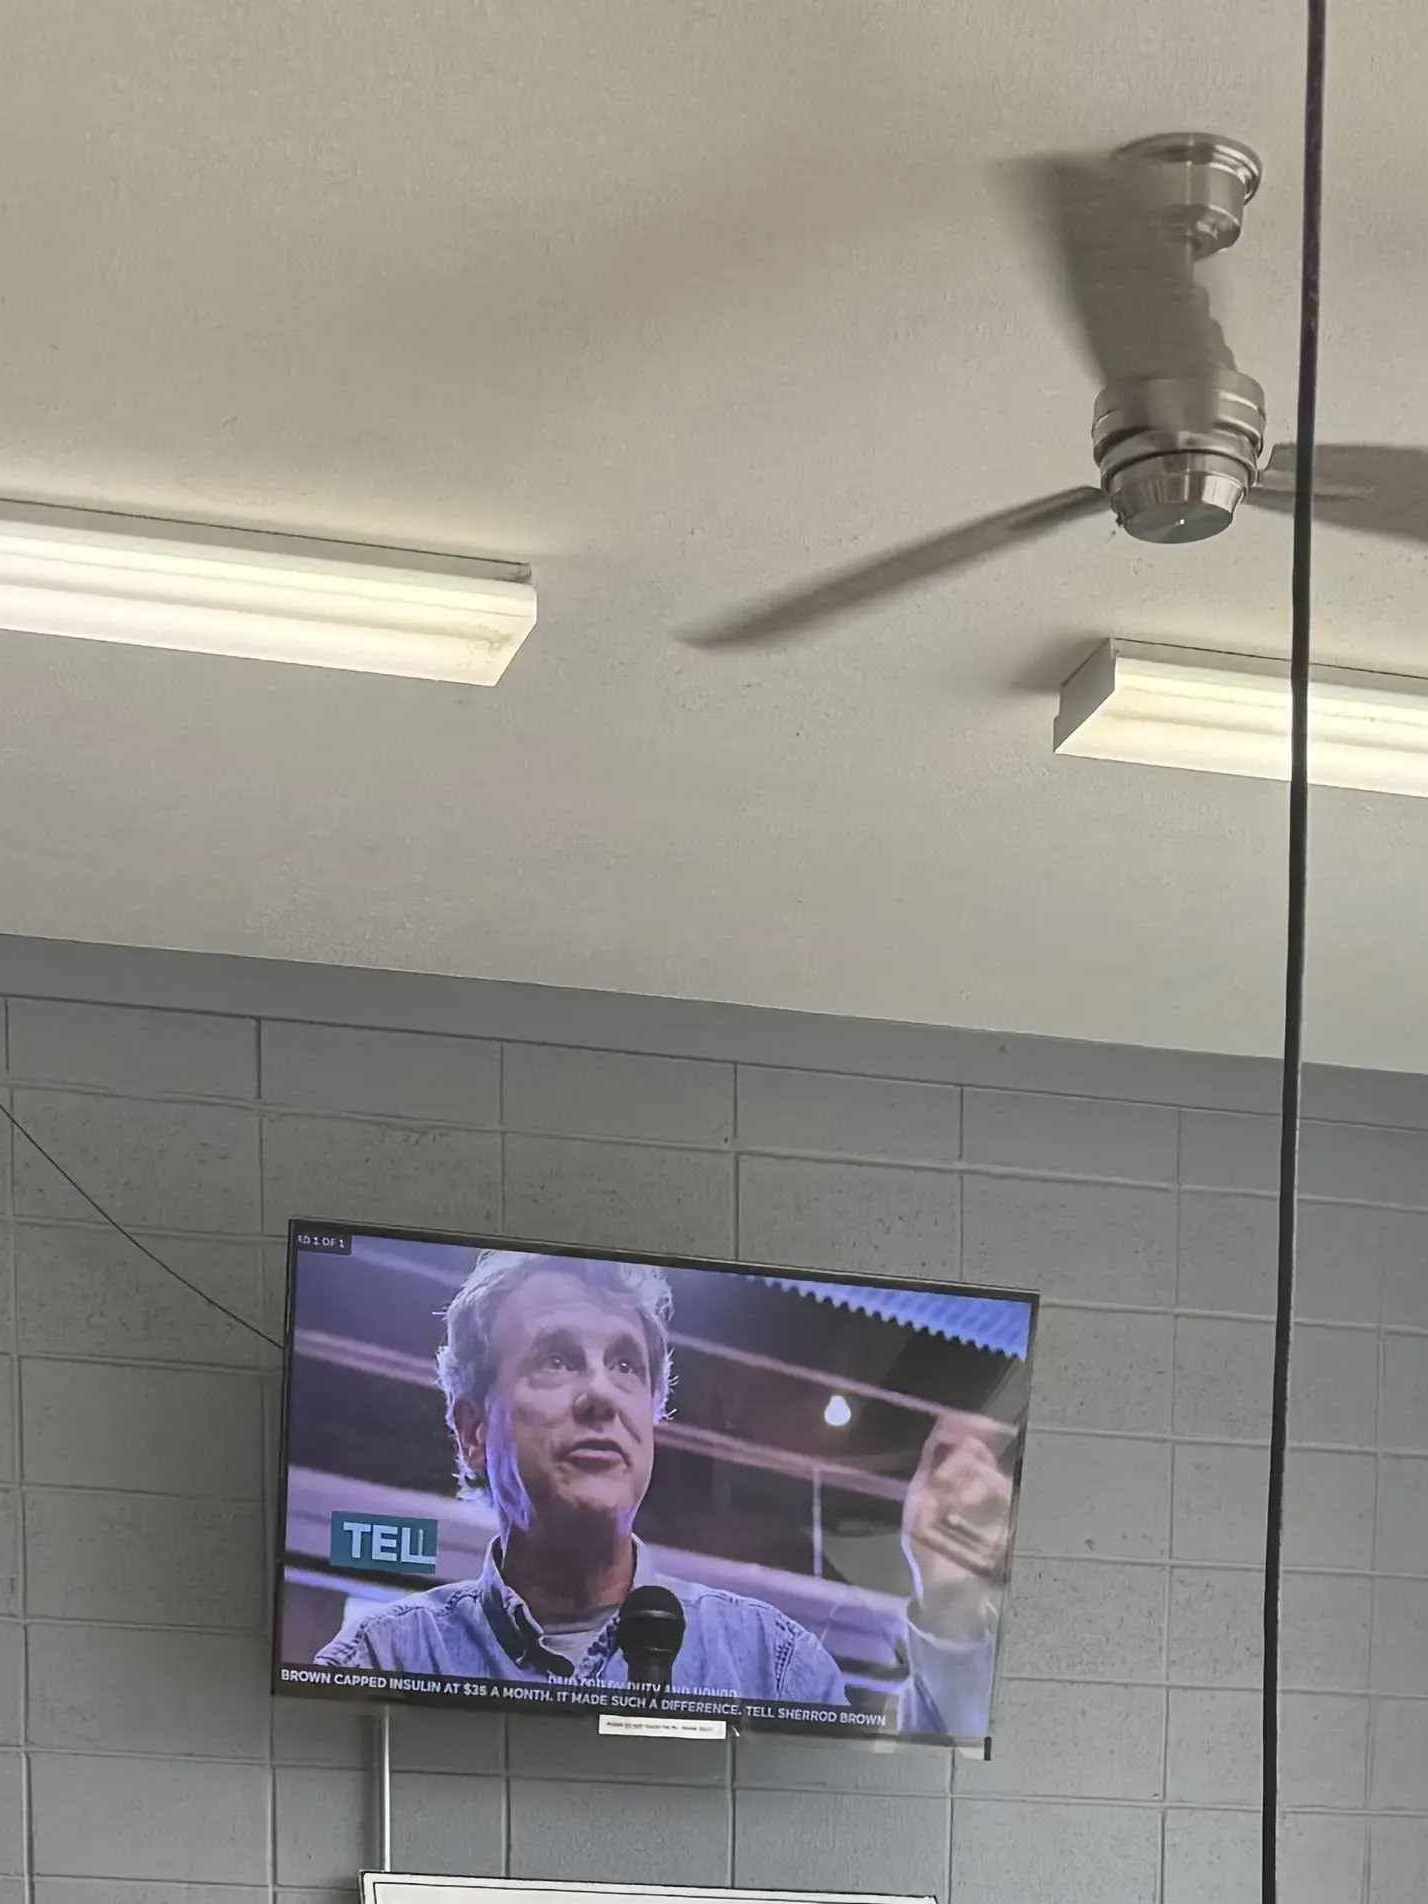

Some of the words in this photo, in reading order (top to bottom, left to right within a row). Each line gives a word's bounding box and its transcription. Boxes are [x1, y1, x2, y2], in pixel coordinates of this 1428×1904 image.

[343, 1522, 436, 1565] TELL
[281, 1669, 331, 1684] BROWN
[334, 1674, 387, 1688] CAPPED
[389, 1677, 440, 1692] INSULIN
[444, 1682, 460, 1694] AT
[463, 1683, 487, 1697] $35
[491, 1685, 500, 1697] A
[503, 1687, 553, 1702] MONTH.
[557, 1691, 569, 1702] IT
[571, 1693, 607, 1706] MADE
[611, 1695, 646, 1709] SUCH
[648, 1697, 658, 1709] A
[661, 1699, 742, 1716] DIFFERENCE.
[746, 1705, 775, 1719] TELL
[778, 1707, 837, 1723] SHERROD
[839, 1711, 887, 1727] BROWN
